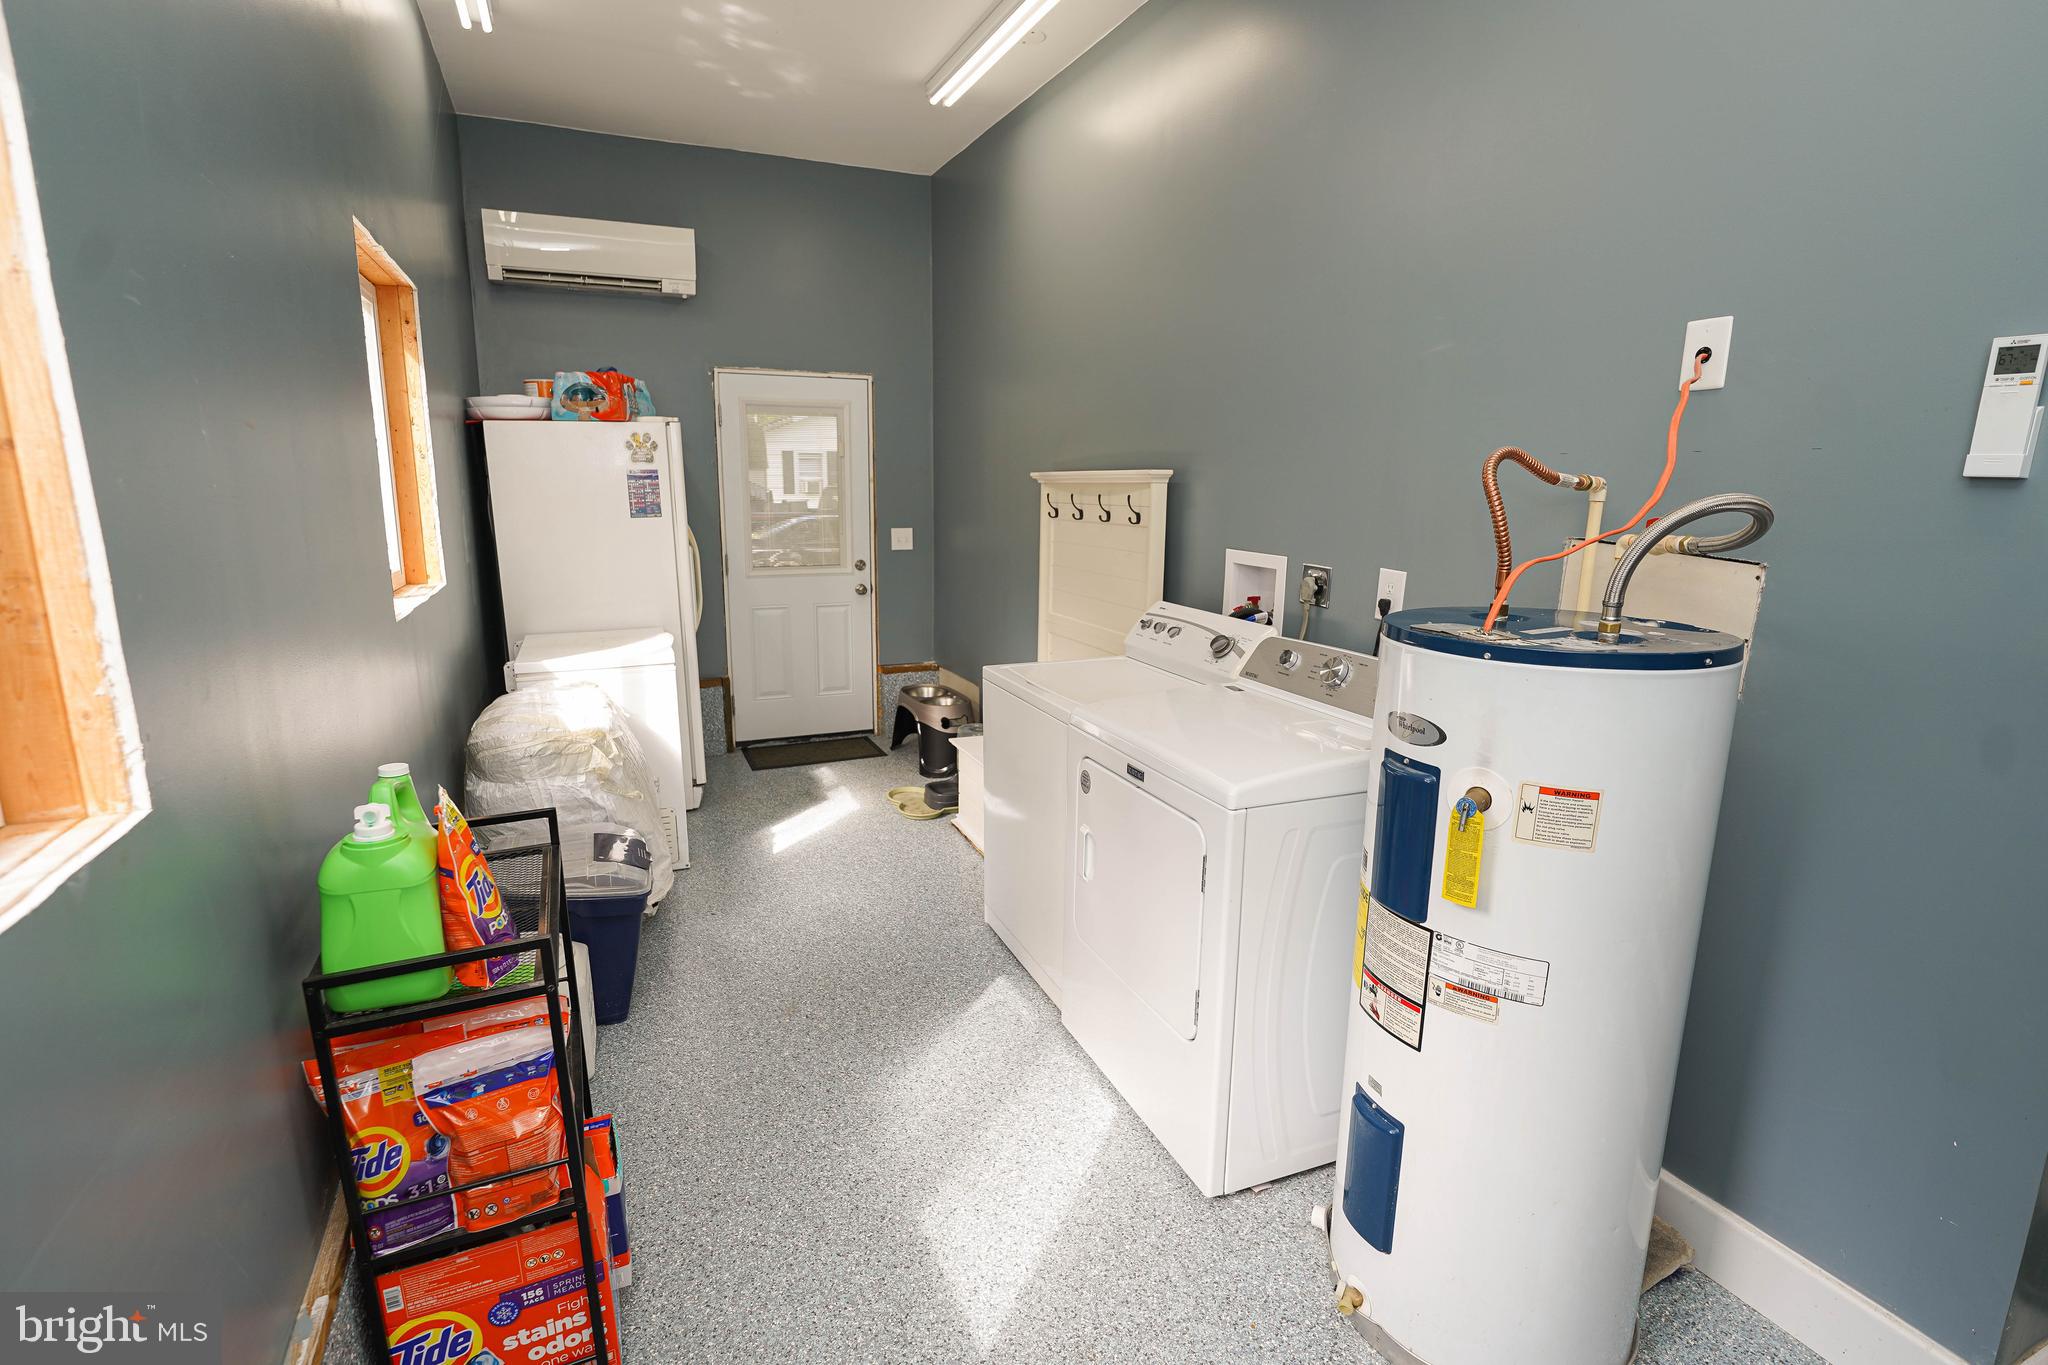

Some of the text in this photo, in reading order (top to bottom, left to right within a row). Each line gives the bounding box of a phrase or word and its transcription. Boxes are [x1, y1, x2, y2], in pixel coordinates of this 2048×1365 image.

[1554, 790, 1591, 799] WARNING
[1457, 986, 1491, 1001] WARNING
[351, 1139, 403, 1182] Tide
[521, 1287, 544, 1300] 156
[523, 1296, 545, 1306] PACS
[503, 1311, 587, 1351] stains
[389, 1323, 473, 1365] Tide
